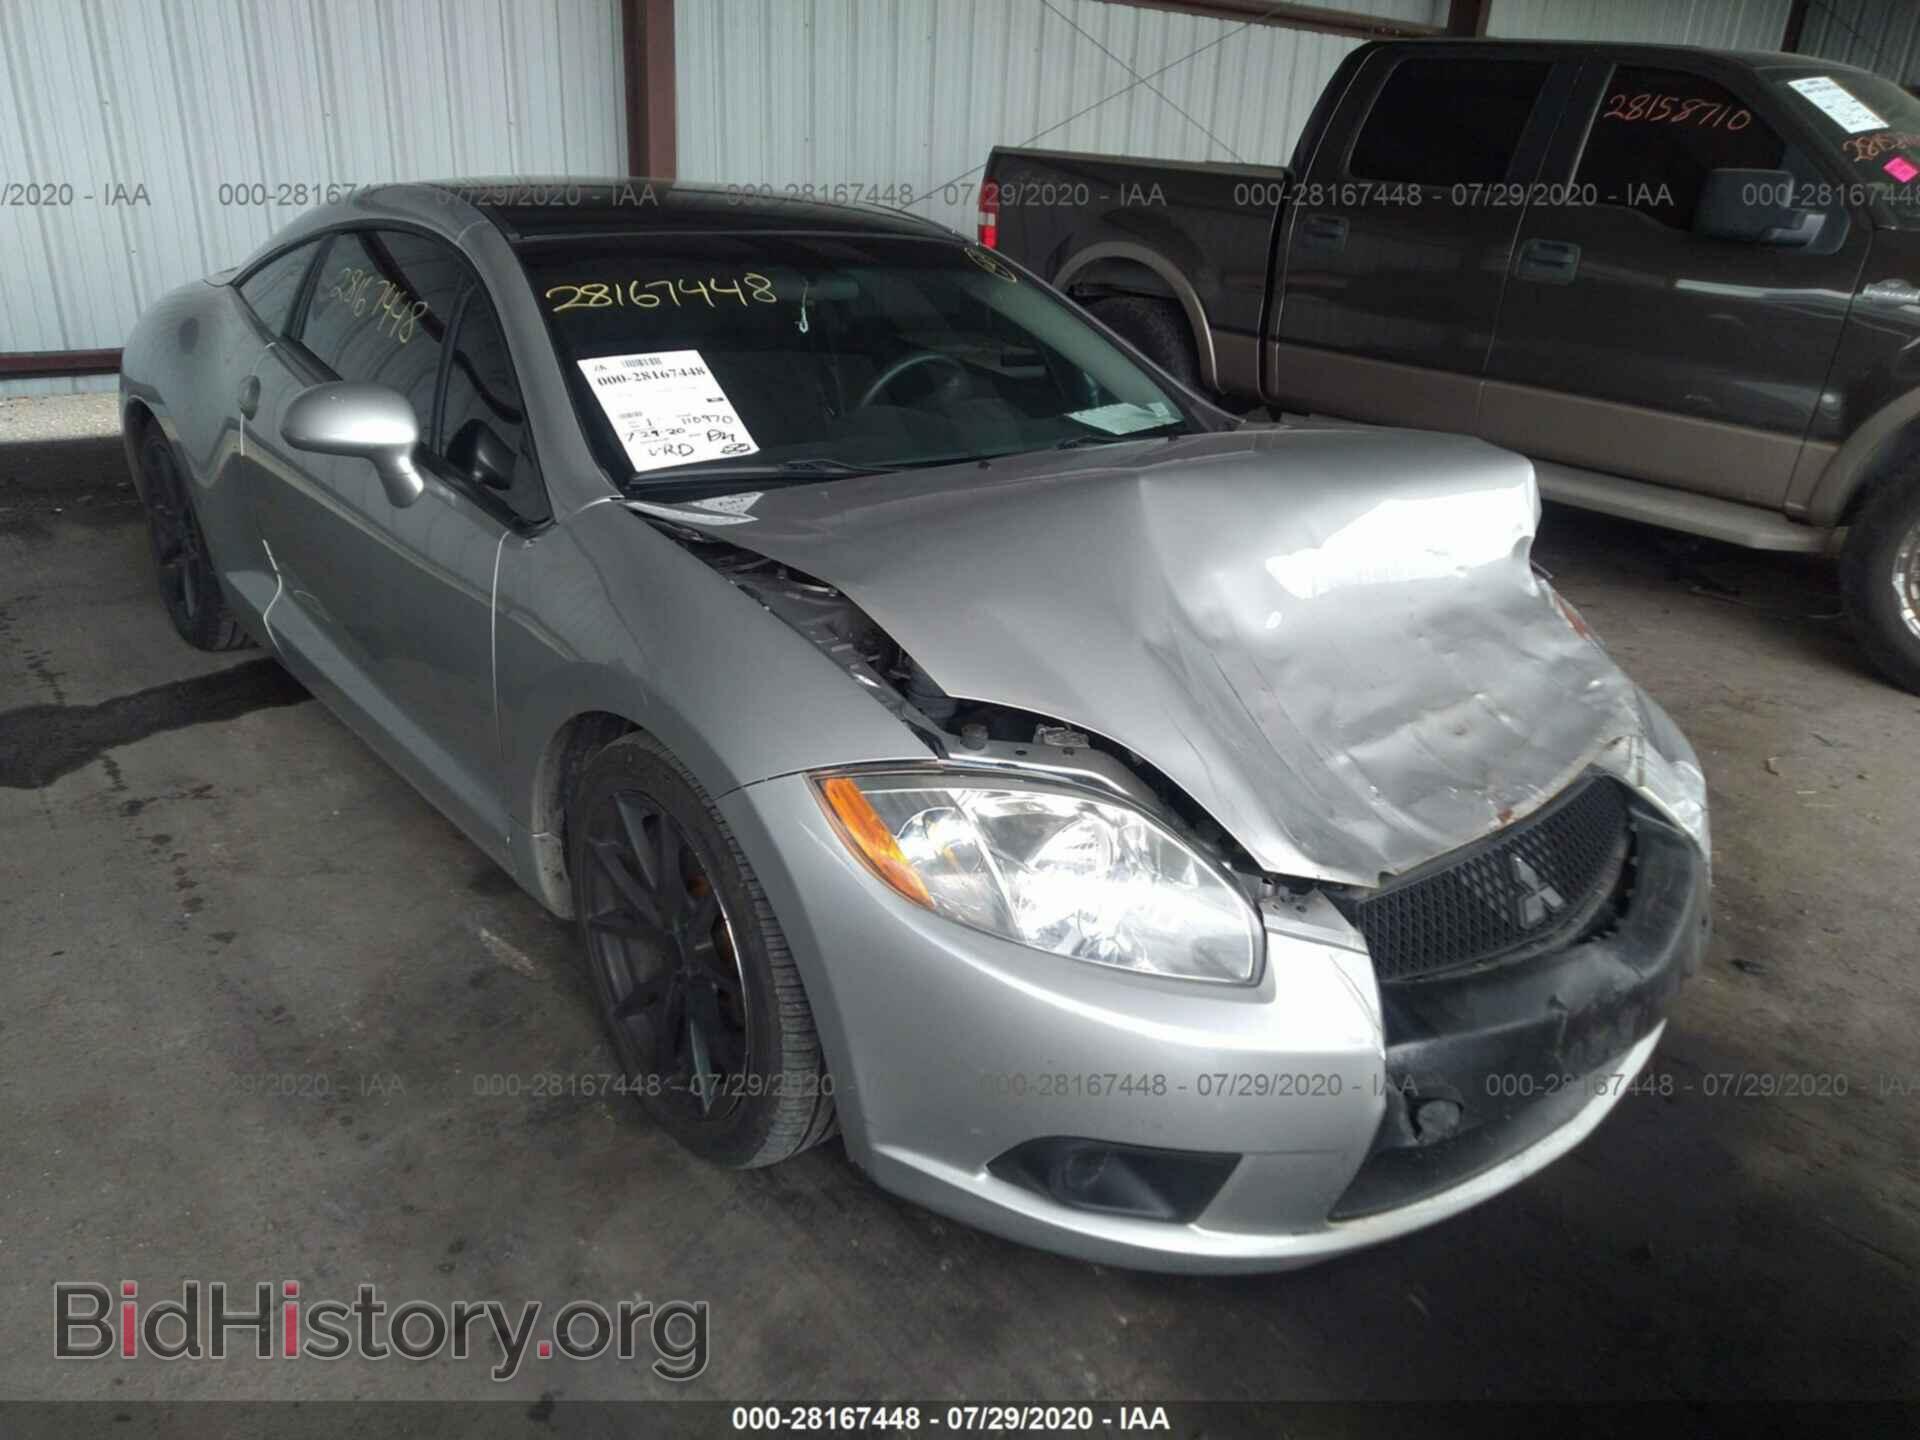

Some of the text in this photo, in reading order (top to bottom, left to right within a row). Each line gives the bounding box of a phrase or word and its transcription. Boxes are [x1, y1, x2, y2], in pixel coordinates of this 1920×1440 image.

[1604, 94, 1751, 130] 28158710
[331, 267, 428, 343] 28167448
[545, 272, 777, 313] 28167448
[597, 366, 706, 386] 000-28167448
